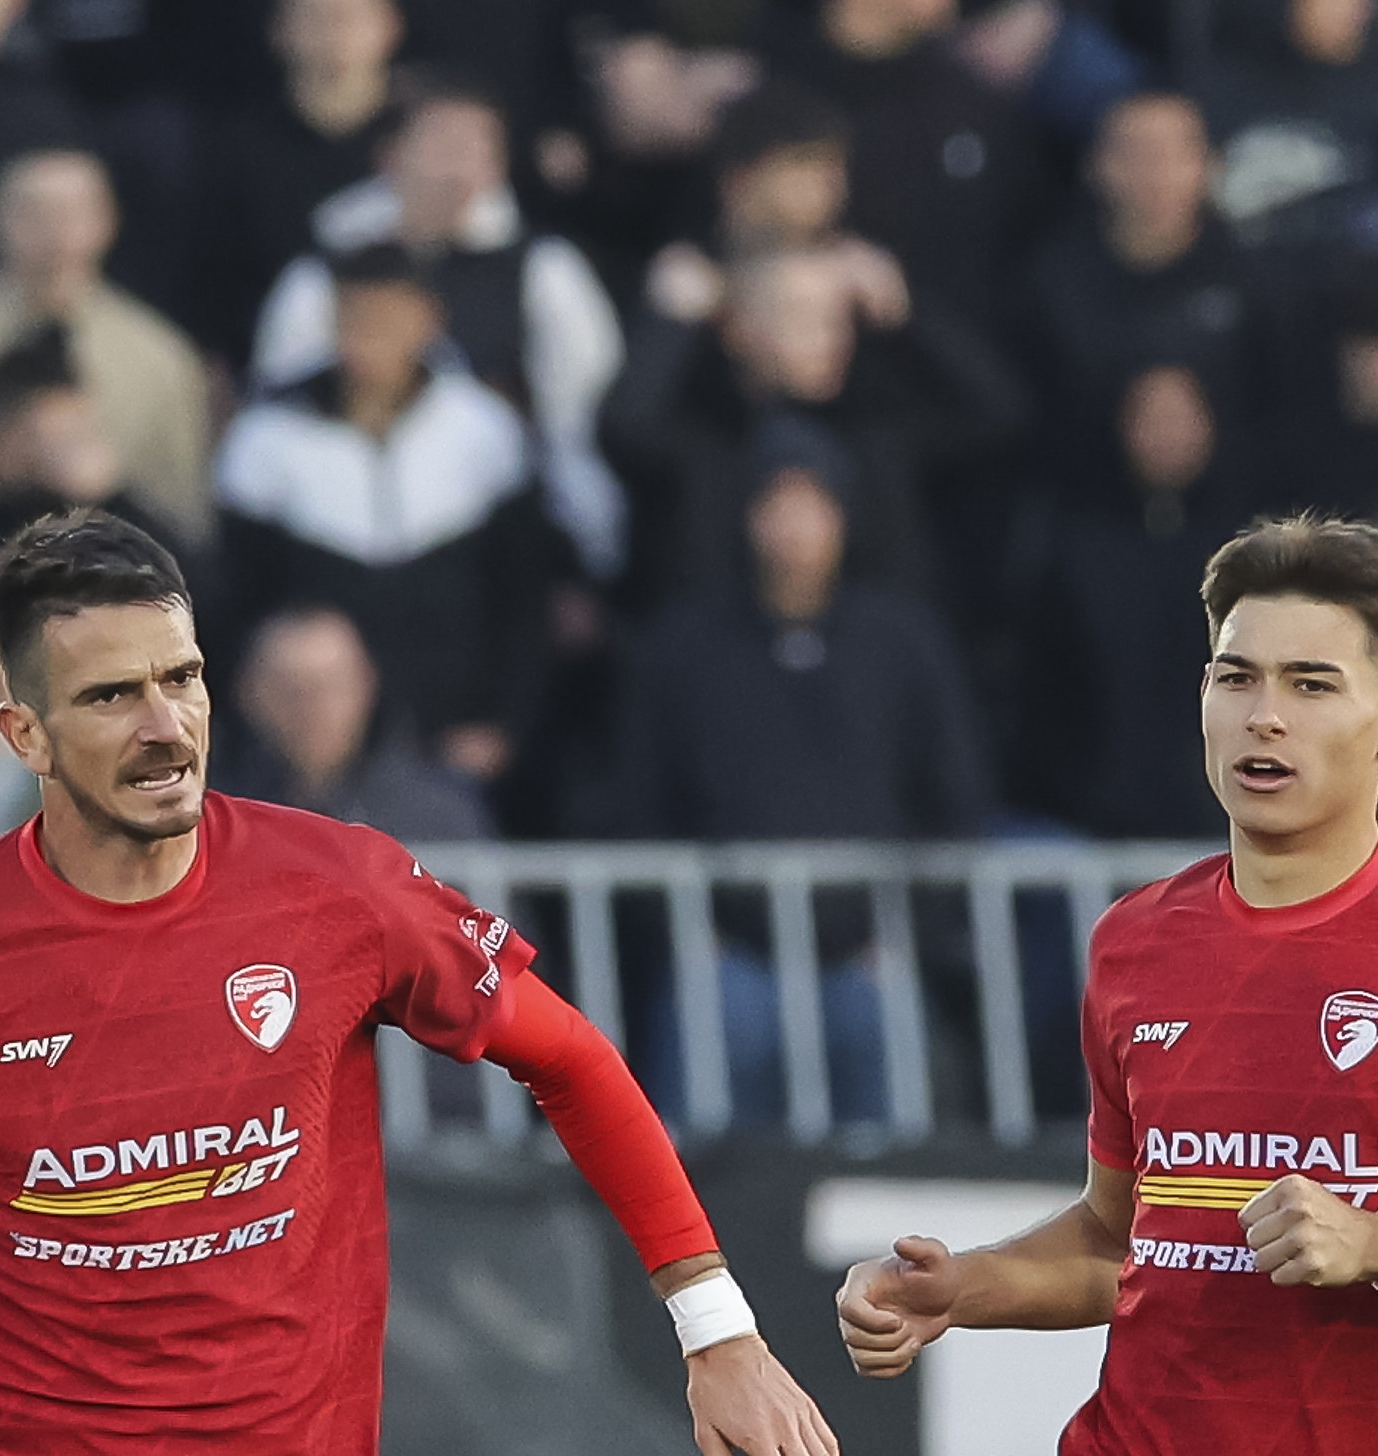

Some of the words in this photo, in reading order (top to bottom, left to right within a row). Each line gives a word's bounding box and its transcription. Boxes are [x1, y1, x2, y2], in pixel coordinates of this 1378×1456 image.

[23, 1105, 301, 1189] ADMIRAL
[210, 1145, 299, 1199] BET
[13, 1208, 296, 1271] SPORTSKE.NET
[1132, 1237, 1259, 1274] SPORTSK
